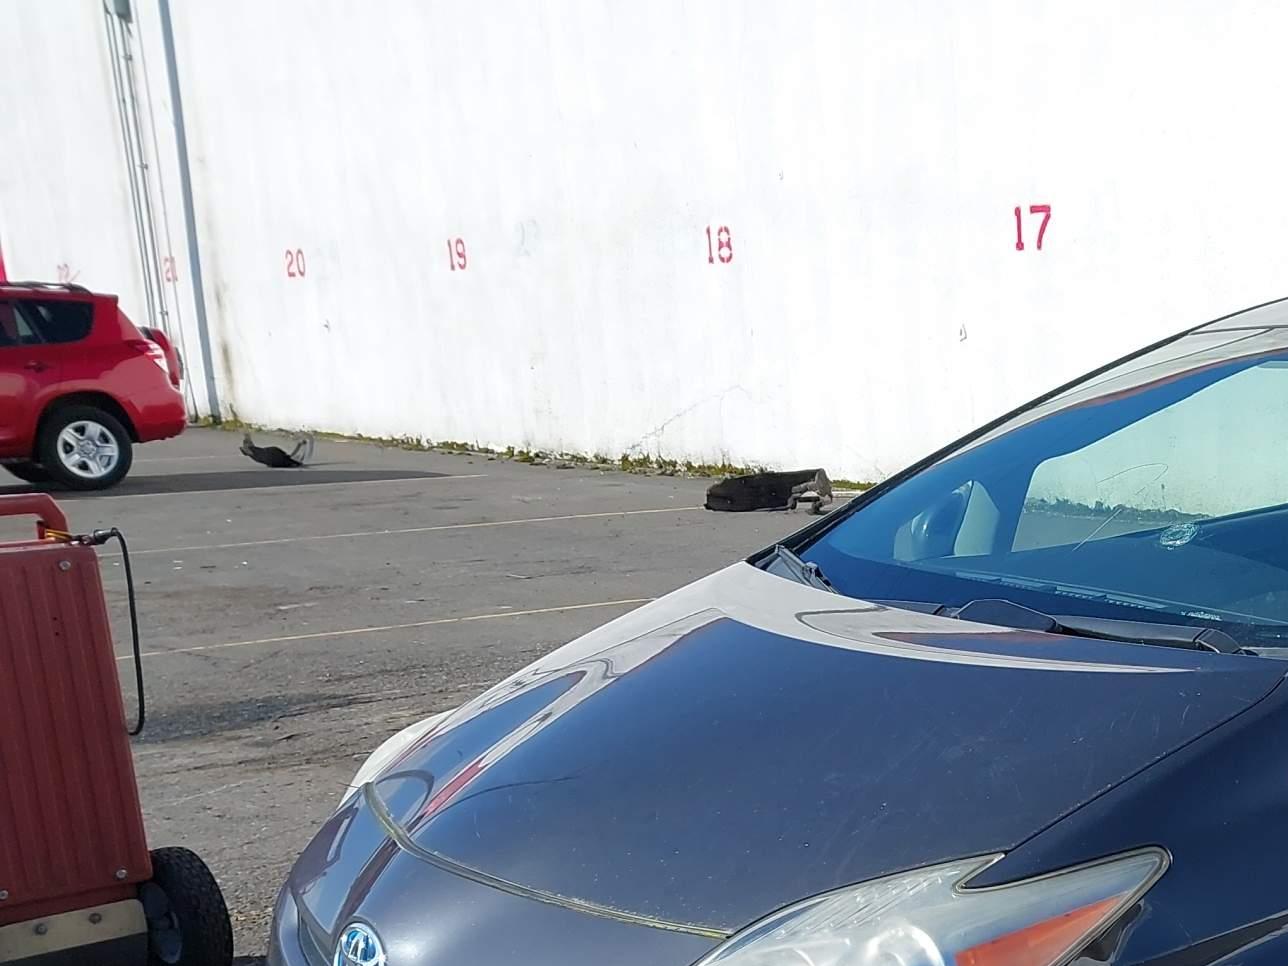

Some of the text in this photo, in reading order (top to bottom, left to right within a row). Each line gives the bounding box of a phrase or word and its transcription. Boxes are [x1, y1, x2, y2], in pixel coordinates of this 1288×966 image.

[706, 225, 733, 264] 18
[1013, 203, 1053, 252] 17
[284, 248, 306, 278] 20
[446, 237, 468, 271] 19
